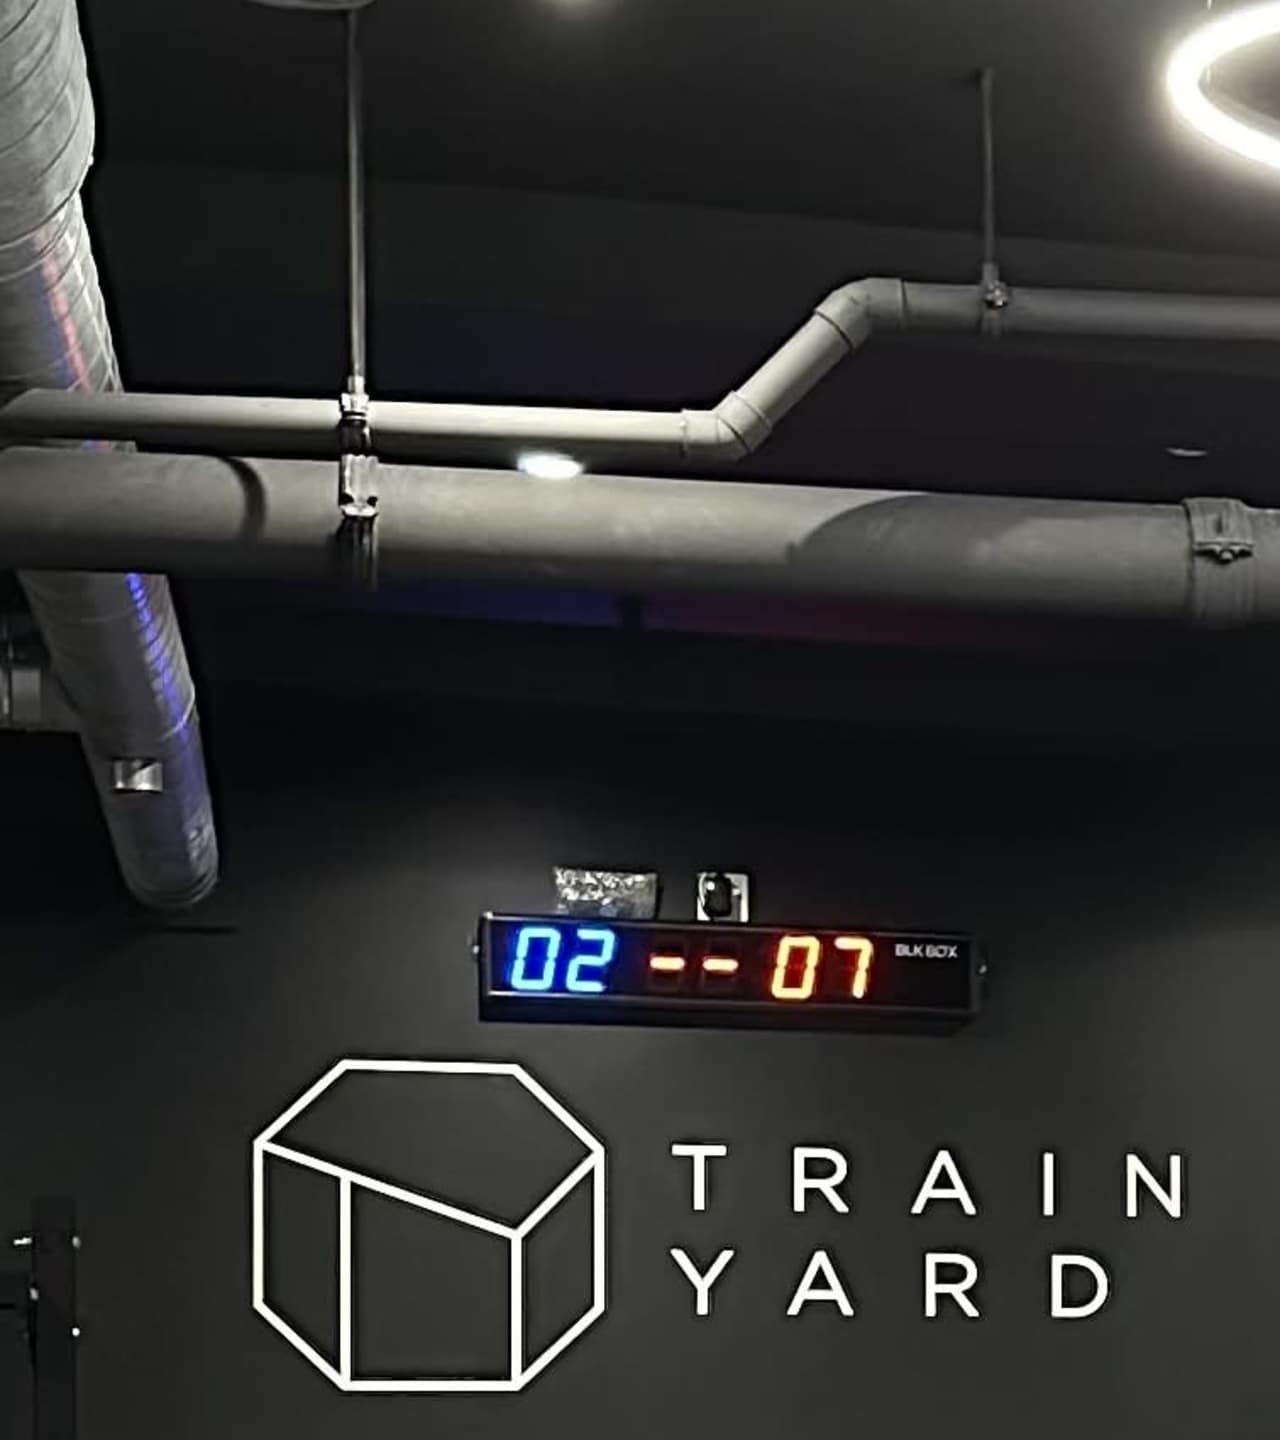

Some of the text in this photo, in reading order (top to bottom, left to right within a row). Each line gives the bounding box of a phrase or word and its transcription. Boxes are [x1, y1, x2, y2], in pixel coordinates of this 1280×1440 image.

[509, 926, 617, 992] 02
[770, 934, 875, 1000] 07
[671, 1143, 1182, 1219] TRAIN
[669, 1247, 1110, 1318] YARD
